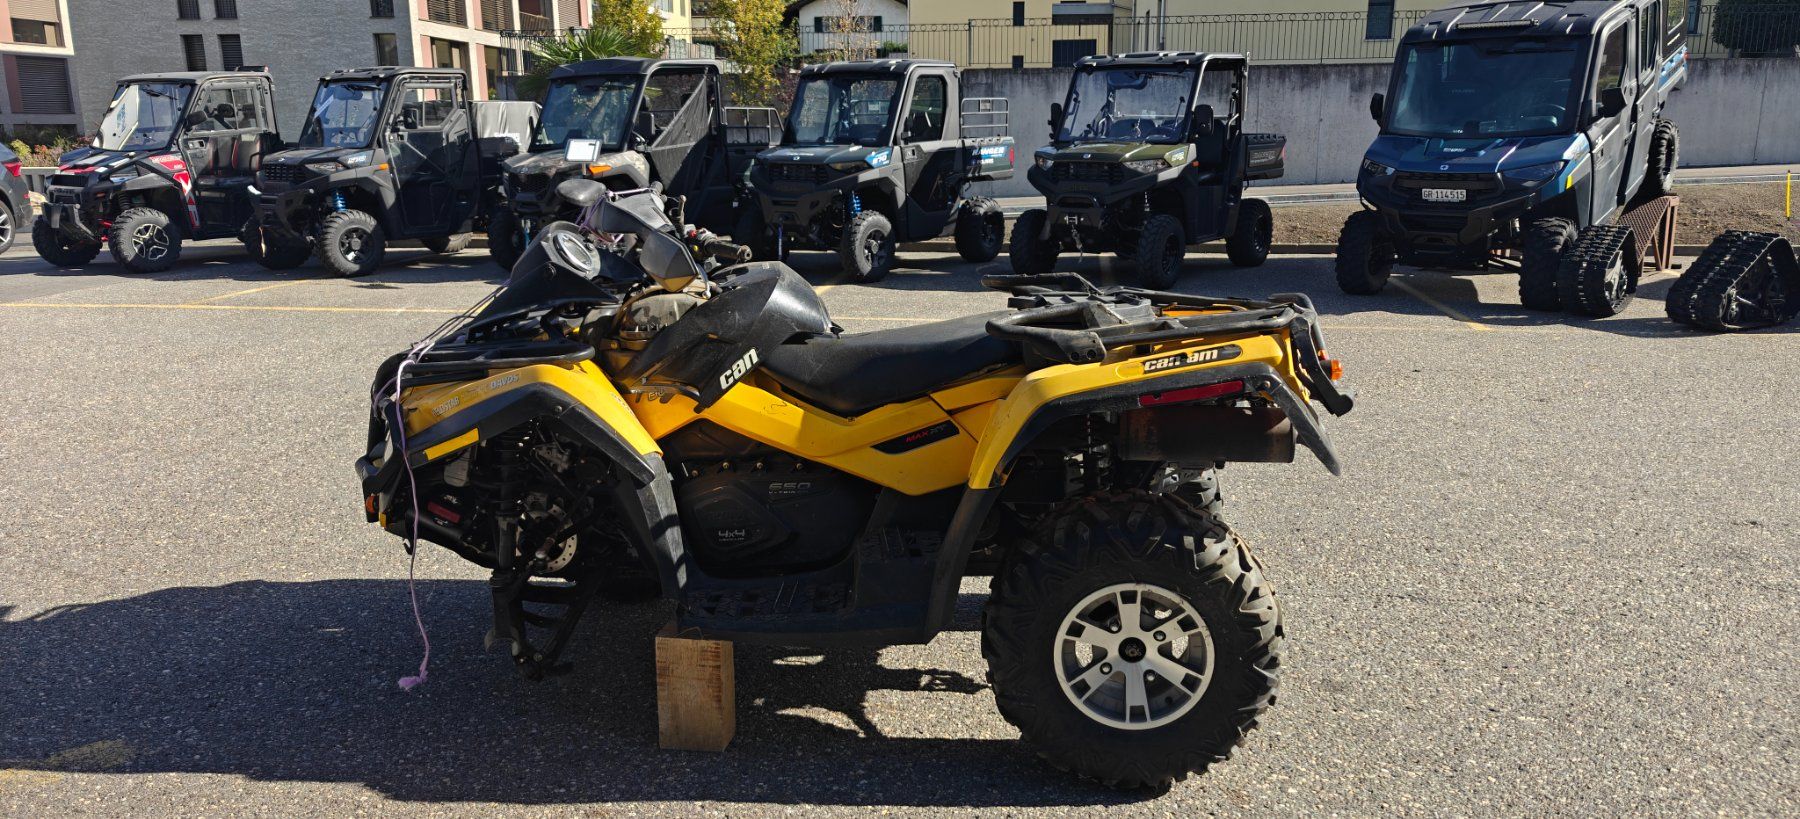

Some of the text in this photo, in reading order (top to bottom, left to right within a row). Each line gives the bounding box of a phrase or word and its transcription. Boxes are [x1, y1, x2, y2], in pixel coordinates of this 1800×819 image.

[1423, 190, 1465, 199] GR 114515
[1144, 349, 1219, 371] can am
[719, 348, 759, 391] can
[905, 431, 929, 443] MAX
[768, 482, 811, 490] 650
